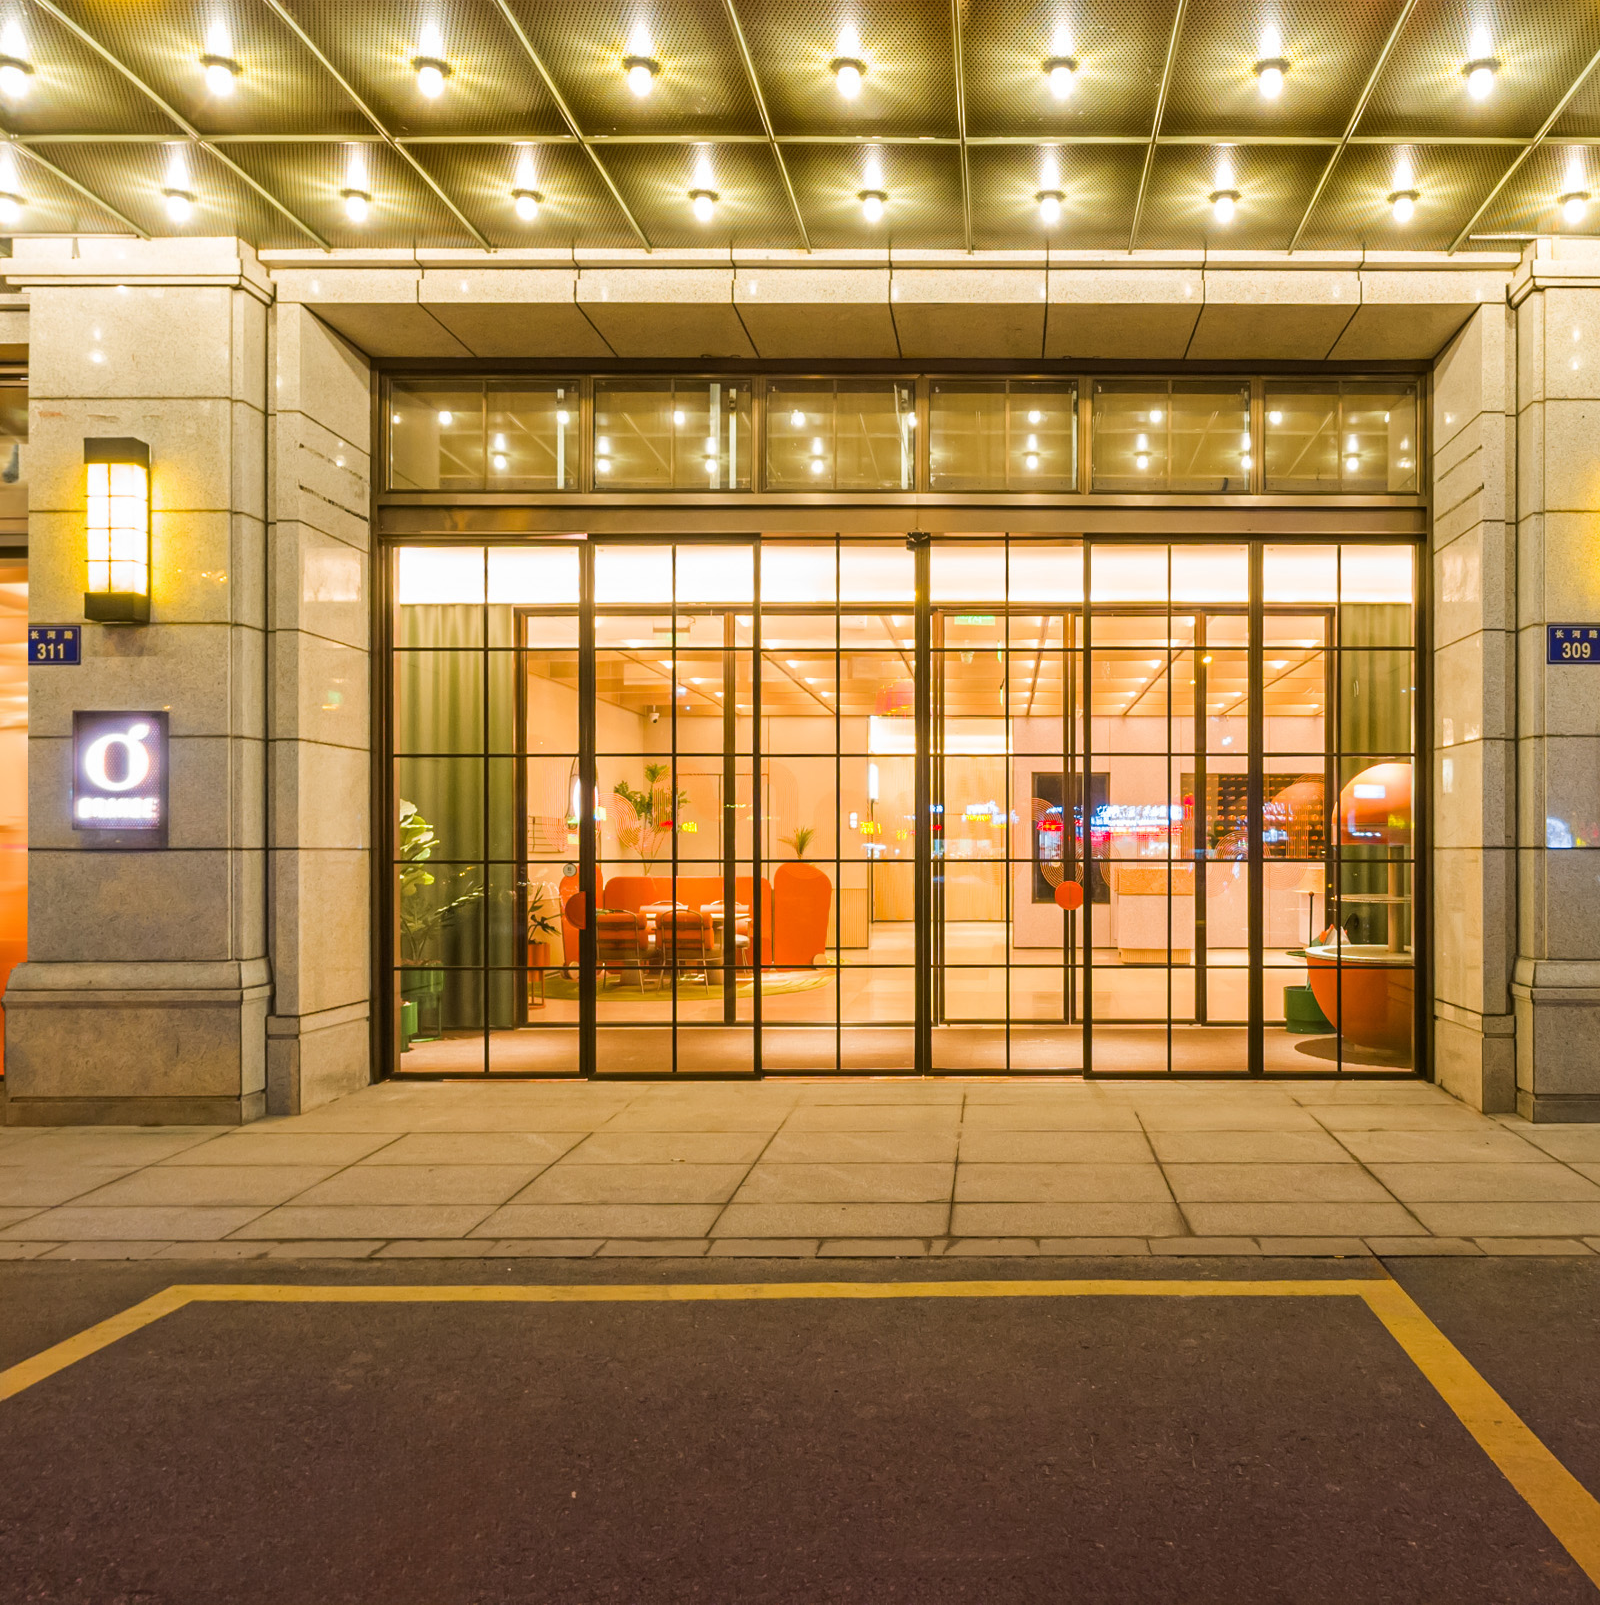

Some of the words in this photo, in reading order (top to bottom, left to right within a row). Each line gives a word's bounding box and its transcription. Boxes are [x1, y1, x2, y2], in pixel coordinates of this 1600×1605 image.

[1554, 629, 1598, 639] 长河路
[36, 642, 65, 660] 311
[1561, 641, 1591, 659] 309
